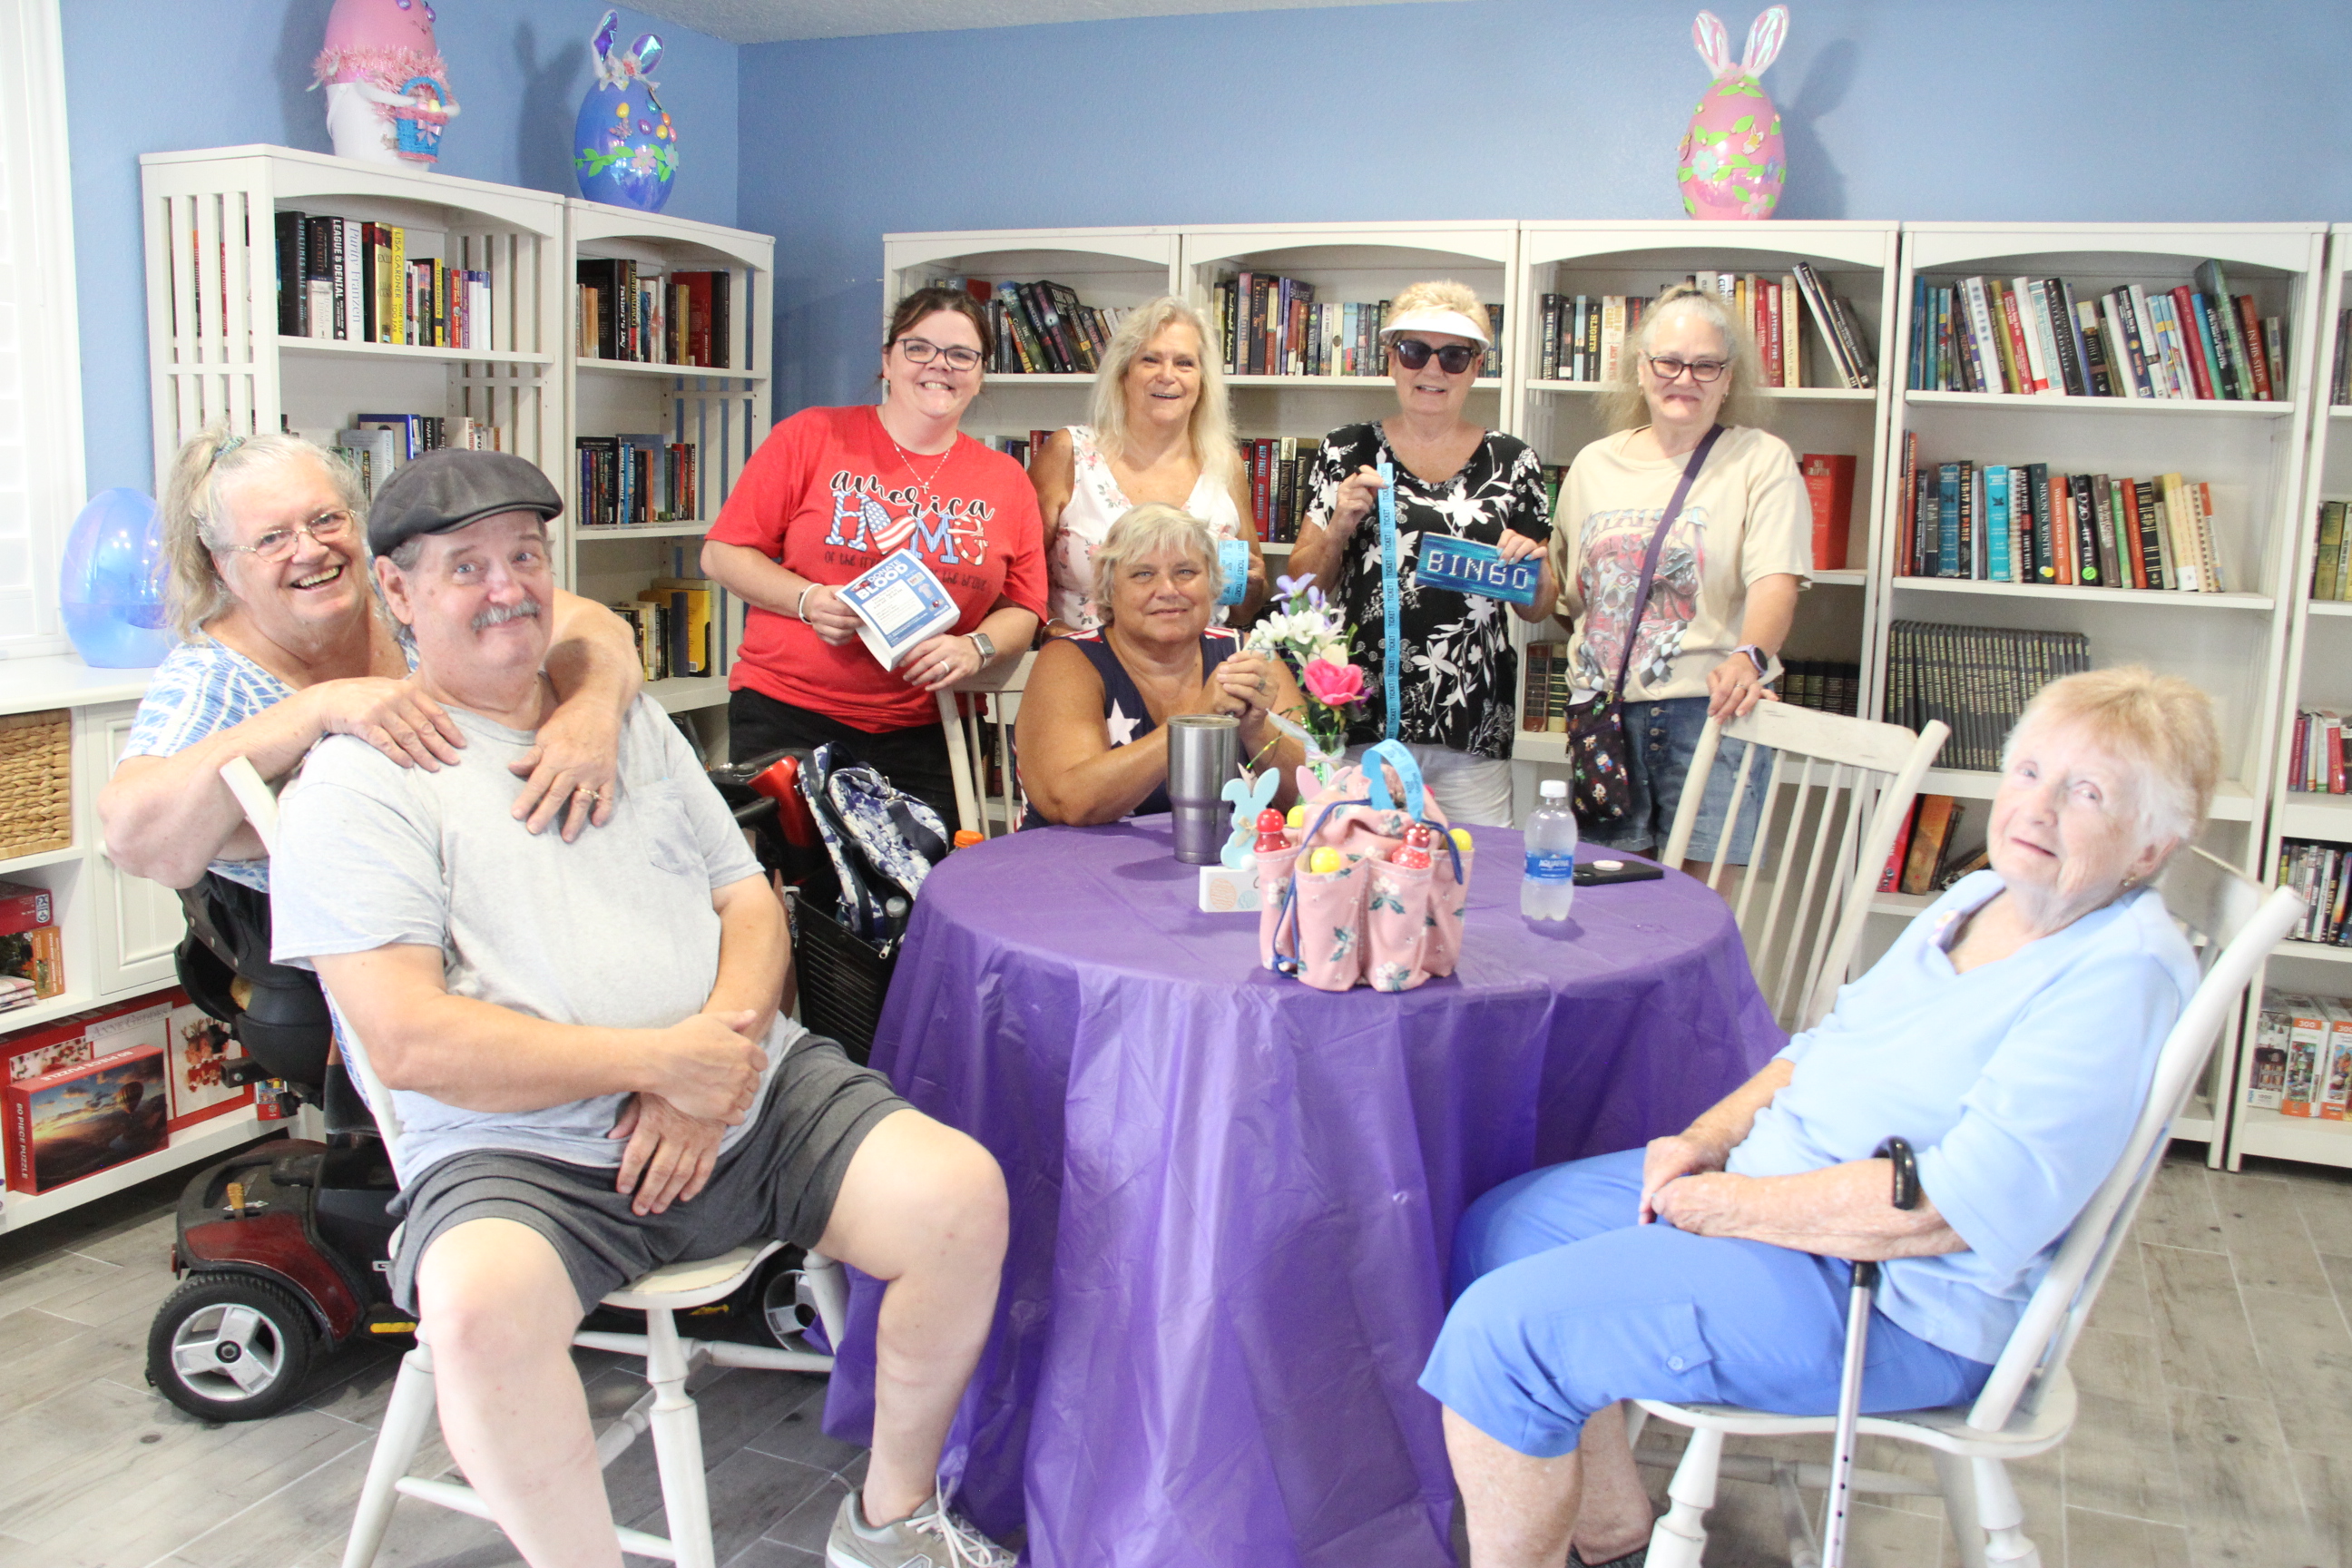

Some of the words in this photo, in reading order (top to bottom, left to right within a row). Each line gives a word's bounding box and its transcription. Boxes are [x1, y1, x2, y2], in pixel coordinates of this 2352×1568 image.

[333, 220, 342, 253] LEAGUE
[348, 228, 360, 265] Purity
[335, 264, 343, 299] DENIAL
[351, 270, 360, 322] Franzen
[2048, 290, 2063, 326] WALTER
[1026, 299, 1044, 333] ARMAGEDDON
[1770, 309, 1779, 342] CATCHING
[1013, 318, 1029, 350] GUARDIANS
[1589, 314, 1597, 352] SLIGHTS
[2247, 329, 2257, 341] IN
[2055, 328, 2072, 373] CRONKITE
[2249, 341, 2259, 358] HIS
[2252, 358, 2265, 383] STEPS
[1259, 446, 1267, 458] DEEP
[1961, 465, 1970, 480] THE
[829, 470, 995, 520] america
[1961, 483, 1970, 502] 15:17
[2053, 488, 2062, 515] WALKING
[1962, 505, 1970, 514] TO
[2042, 513, 2048, 522] IN
[1961, 517, 1970, 541] PARIS
[856, 564, 907, 601] BLOOD
[868, 559, 901, 583] DONATE
[1426, 550, 1529, 590] BINGO
[1388, 610, 1396, 628] TICKET
[40, 1063, 86, 1083] PUZZLE
[83, 1054, 119, 1070] PIECE
[17, 1116, 26, 1143] PIECE
[19, 1144, 29, 1180] PUZZLE
